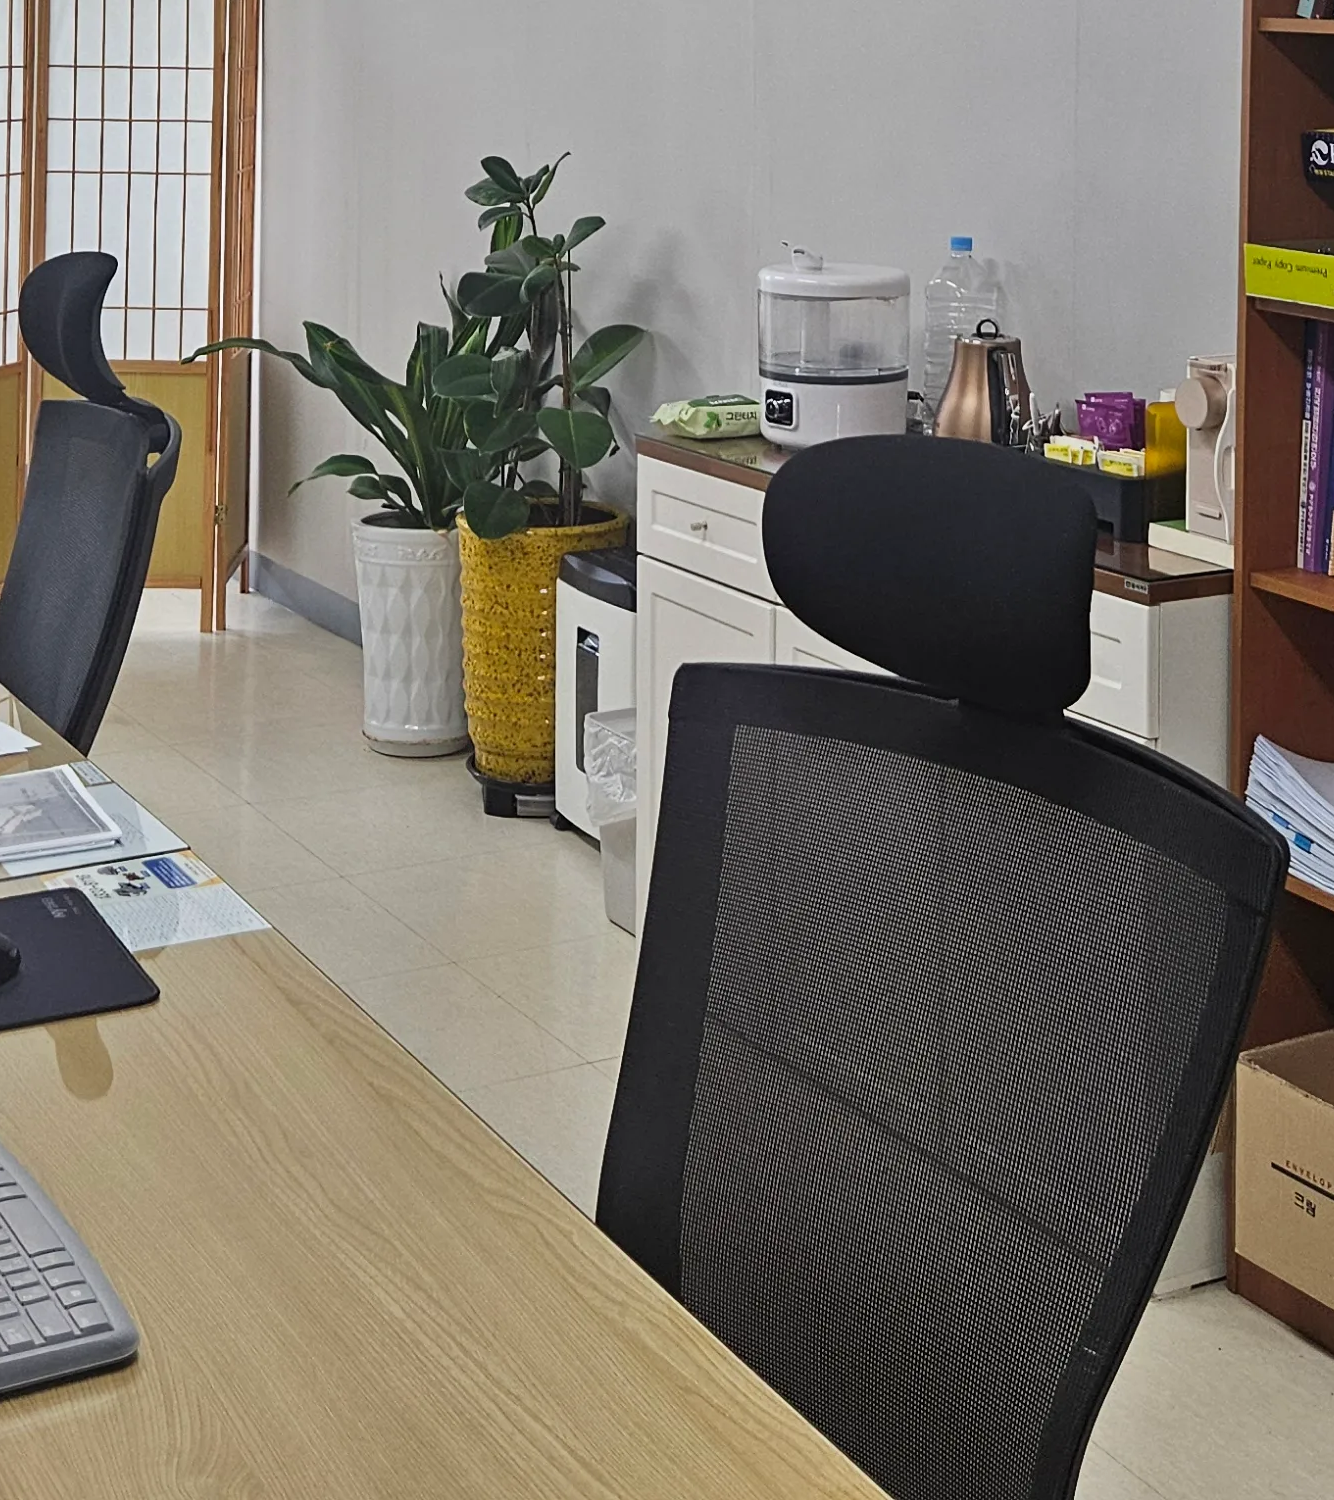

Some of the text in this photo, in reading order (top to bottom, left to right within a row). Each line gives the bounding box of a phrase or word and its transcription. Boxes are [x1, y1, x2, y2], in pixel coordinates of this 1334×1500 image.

[1252, 257, 1328, 278] Premium Copy Paper
